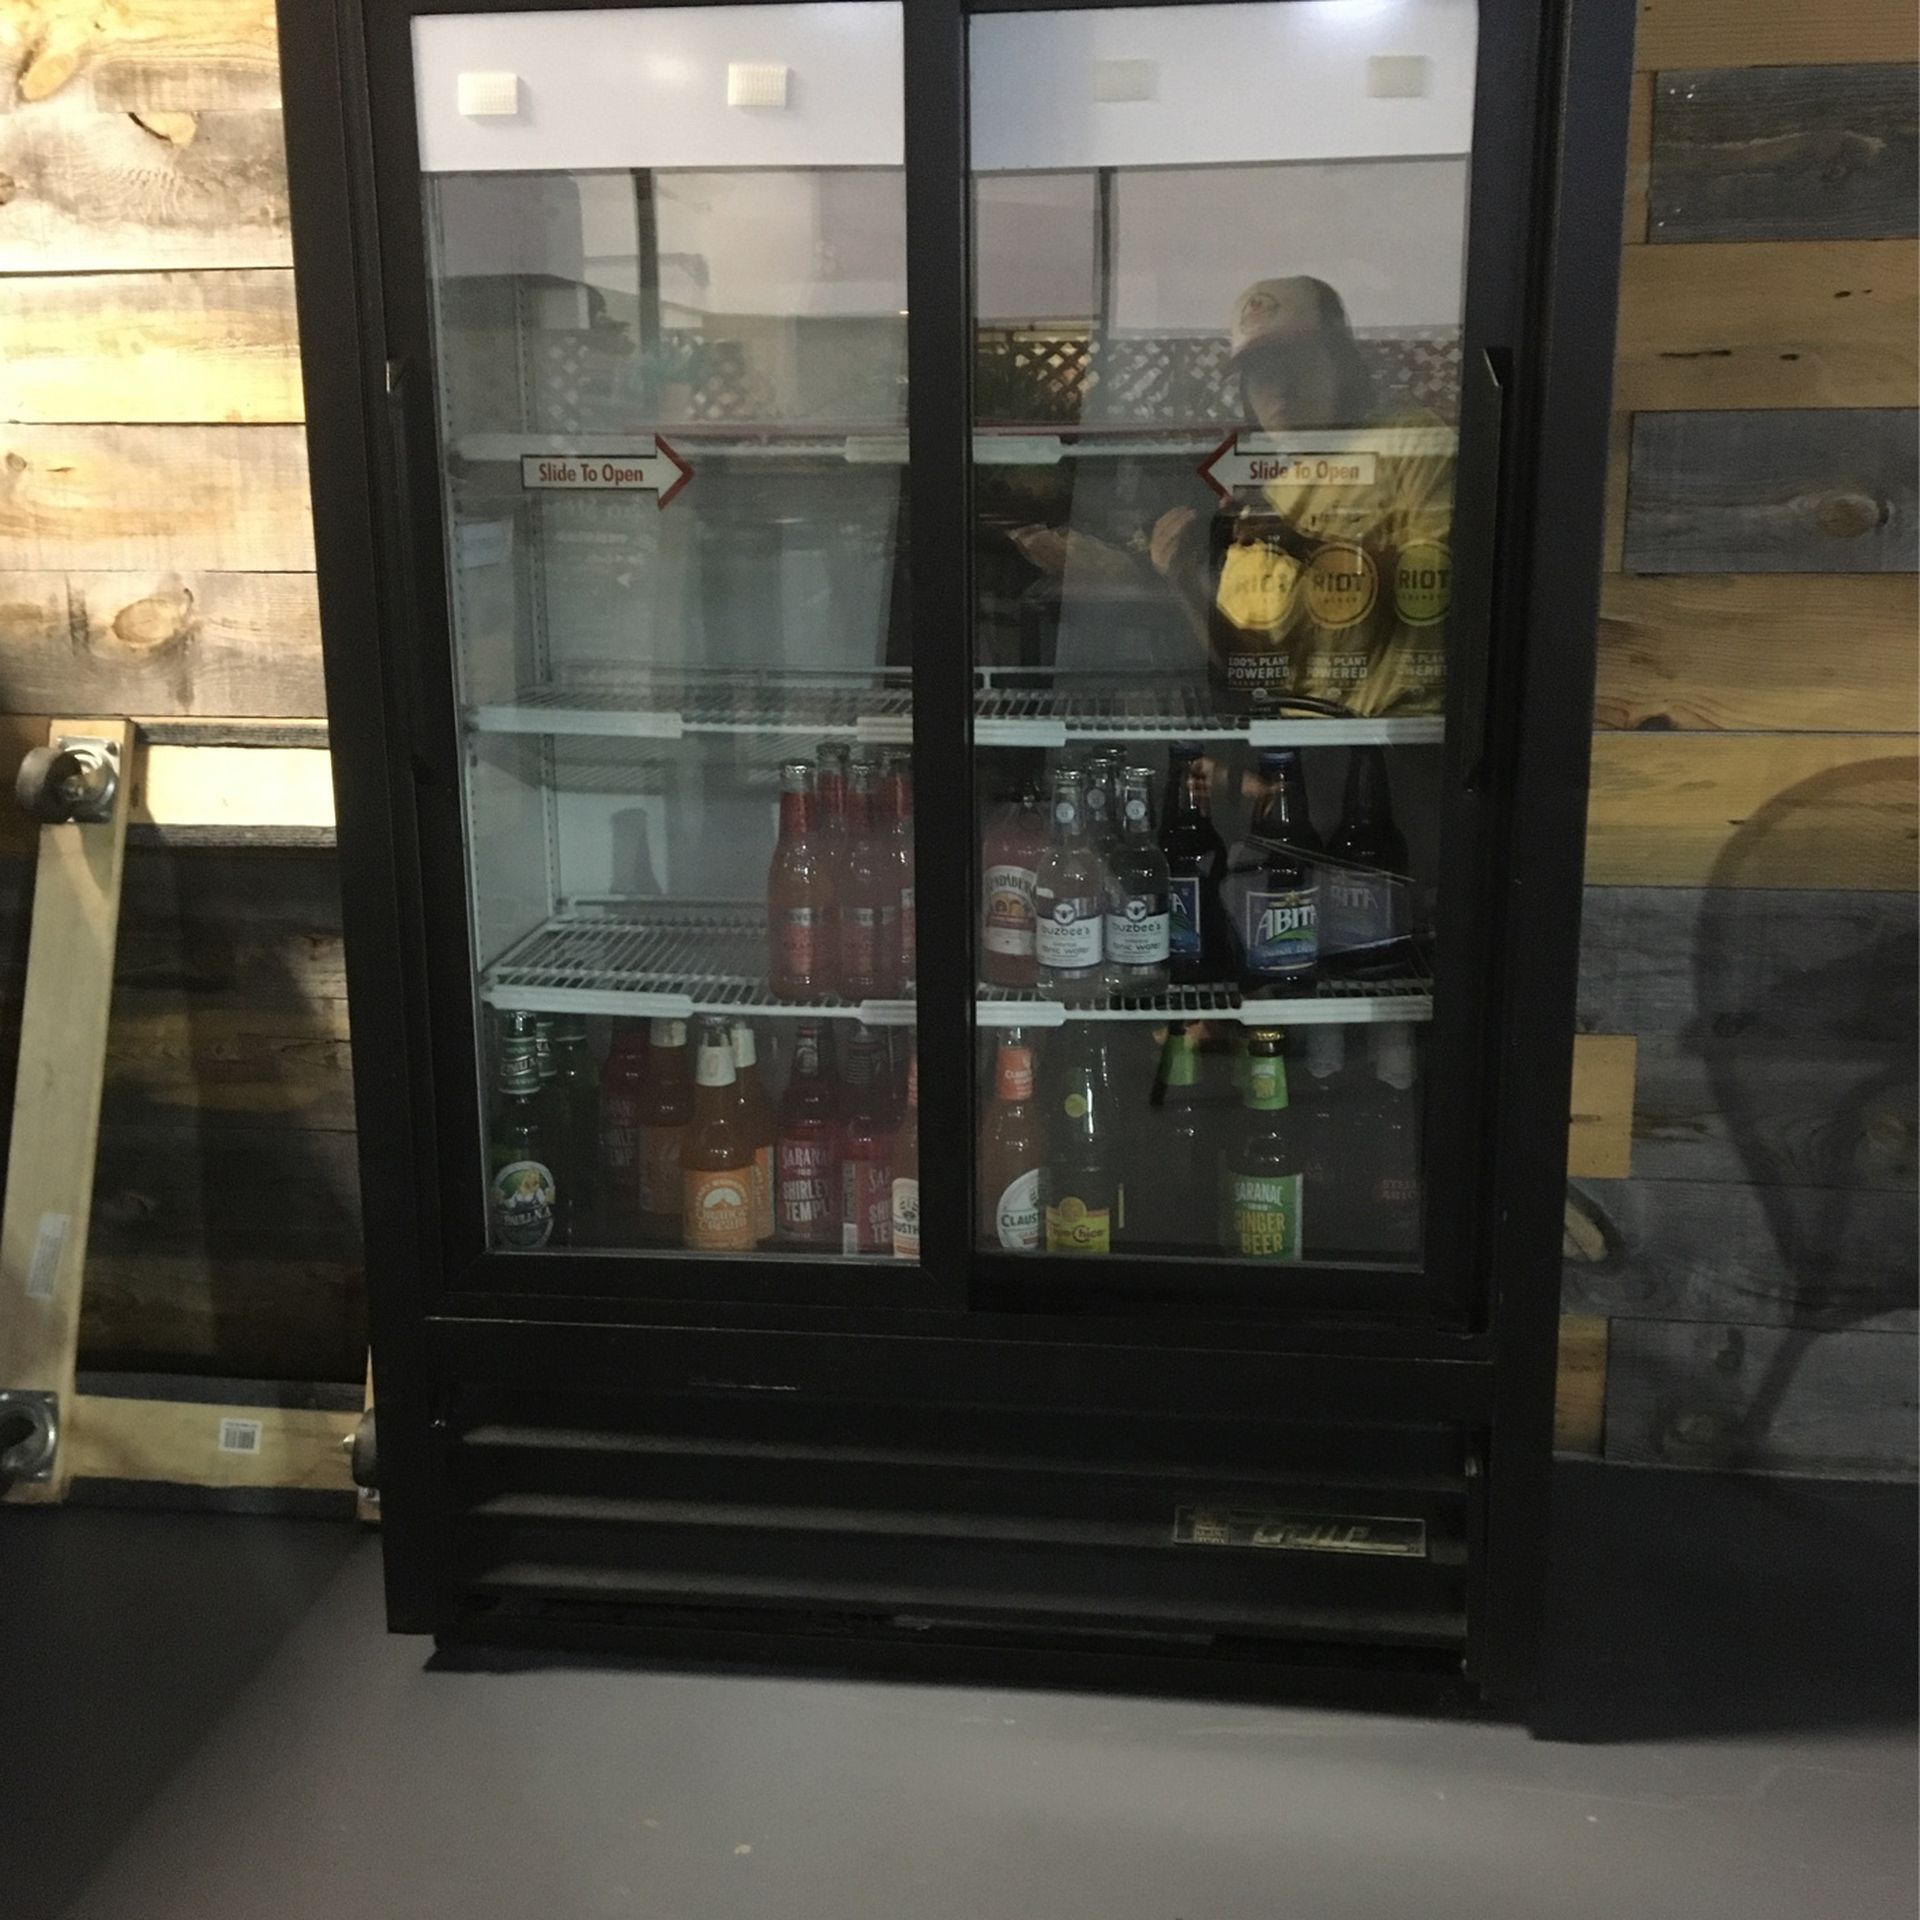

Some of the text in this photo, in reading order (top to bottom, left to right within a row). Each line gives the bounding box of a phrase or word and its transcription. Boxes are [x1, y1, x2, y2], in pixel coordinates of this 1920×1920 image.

[539, 463, 644, 485] Slide To Open
[1250, 461, 1359, 482] Slide To Open
[1313, 573, 1366, 592] RIOT
[1400, 570, 1449, 590] RIOT
[1334, 656, 1367, 667] PLANT
[1228, 666, 1290, 680] POWERED
[1330, 885, 1378, 909] BITA
[1242, 1233, 1283, 1255] BEER
